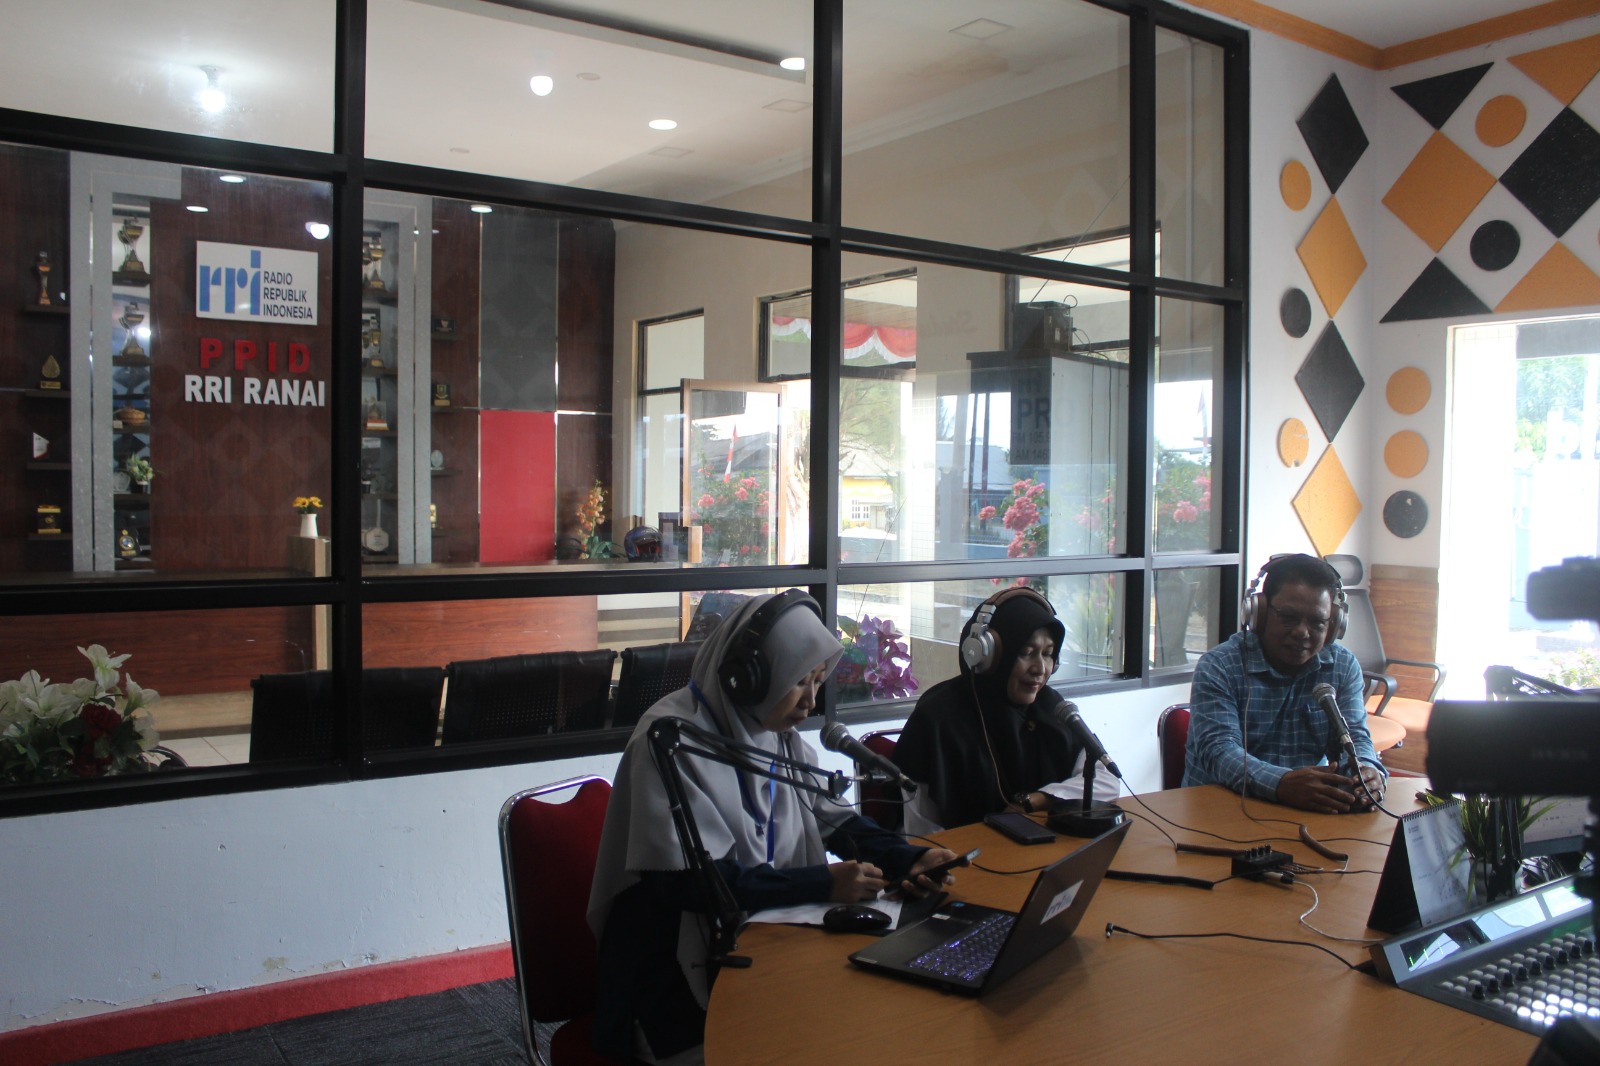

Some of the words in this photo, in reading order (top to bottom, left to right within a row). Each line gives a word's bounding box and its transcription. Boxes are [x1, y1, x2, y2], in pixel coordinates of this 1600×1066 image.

[199, 249, 261, 316] rri
[263, 271, 293, 286] RADIO
[263, 287, 308, 303] REPUBLIK
[263, 303, 313, 319] INDONESIA
[200, 337, 311, 373] PPID
[184, 374, 232, 404] RRI
[243, 377, 326, 407] RANAI
